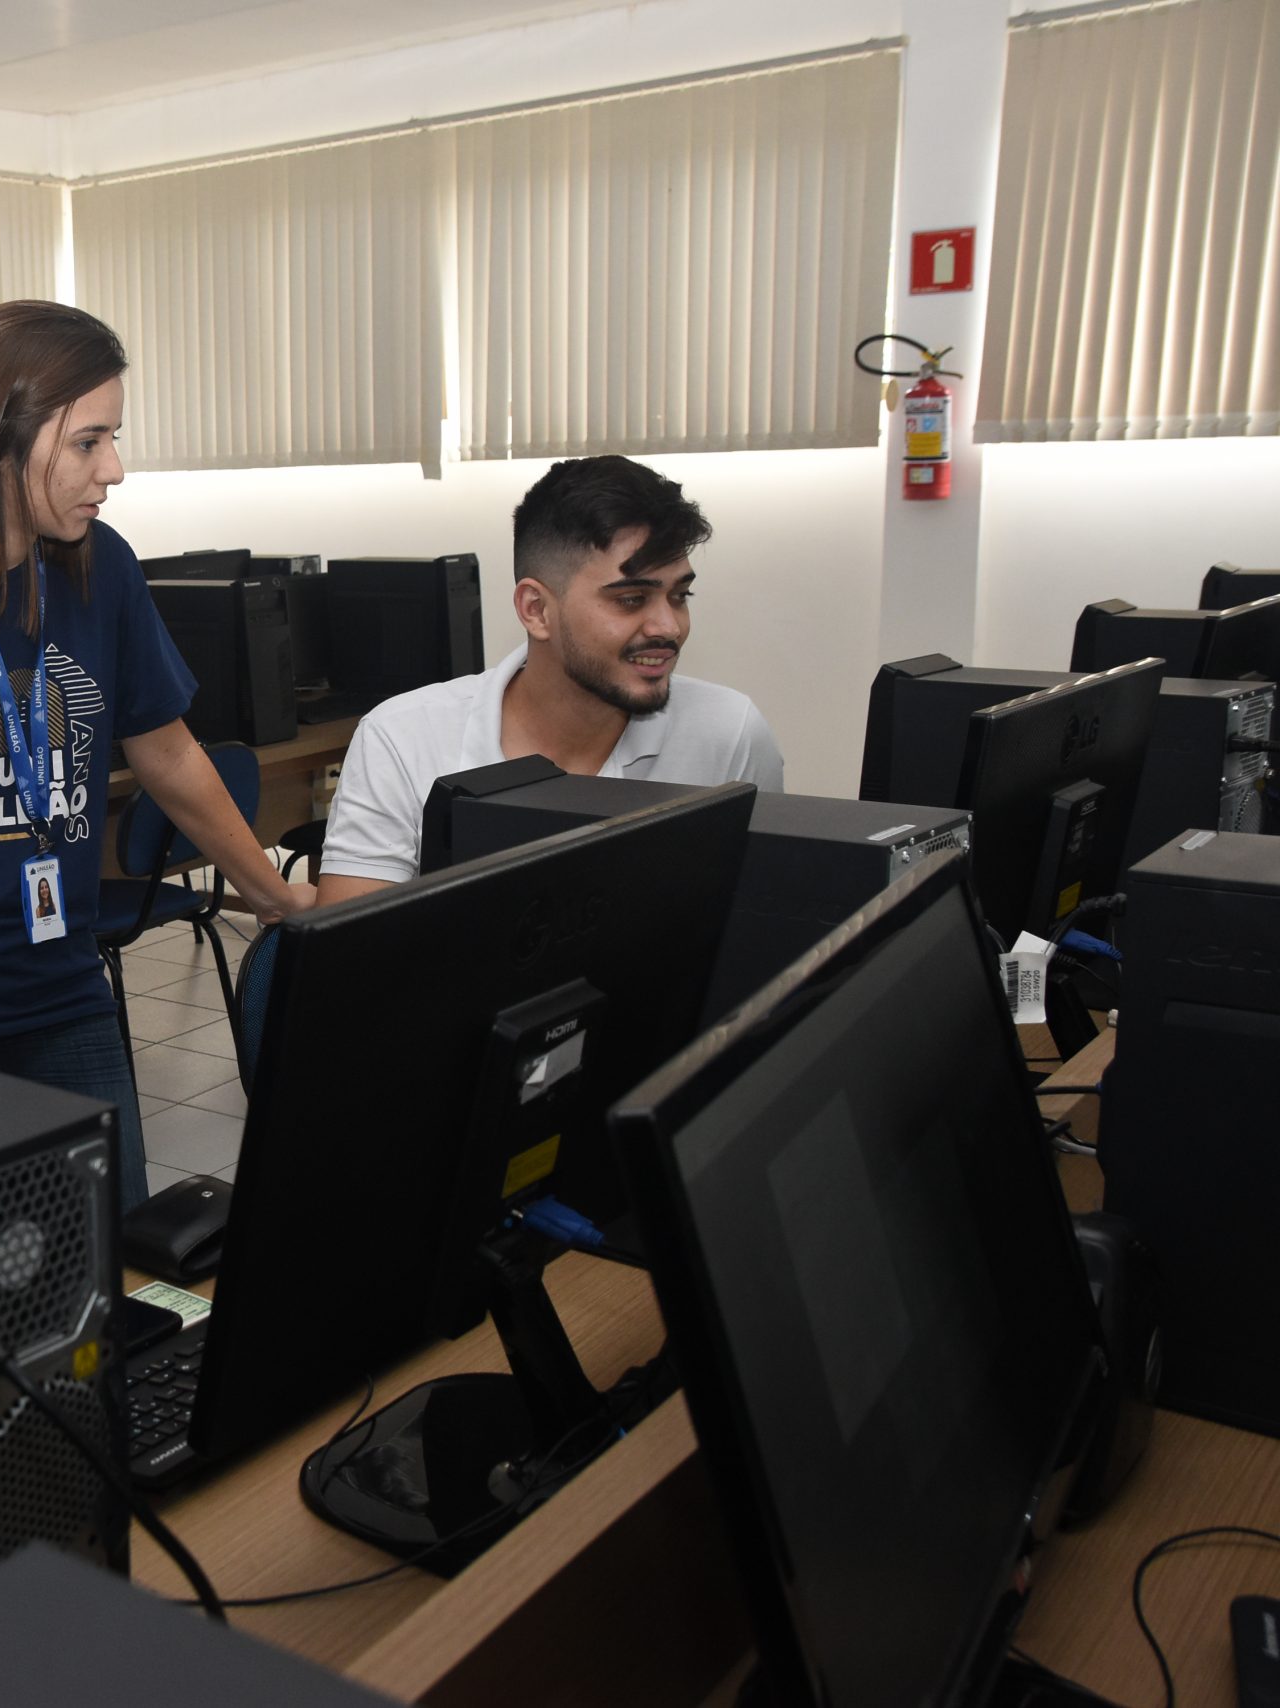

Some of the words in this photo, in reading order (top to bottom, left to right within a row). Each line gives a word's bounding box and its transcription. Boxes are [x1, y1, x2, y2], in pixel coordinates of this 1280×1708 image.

[7, 714, 21, 753] UNILEÃO
[36, 746, 45, 785] UNILEÃO
[64, 719, 95, 843] ANOS
[545, 1018, 579, 1042] HDMI
